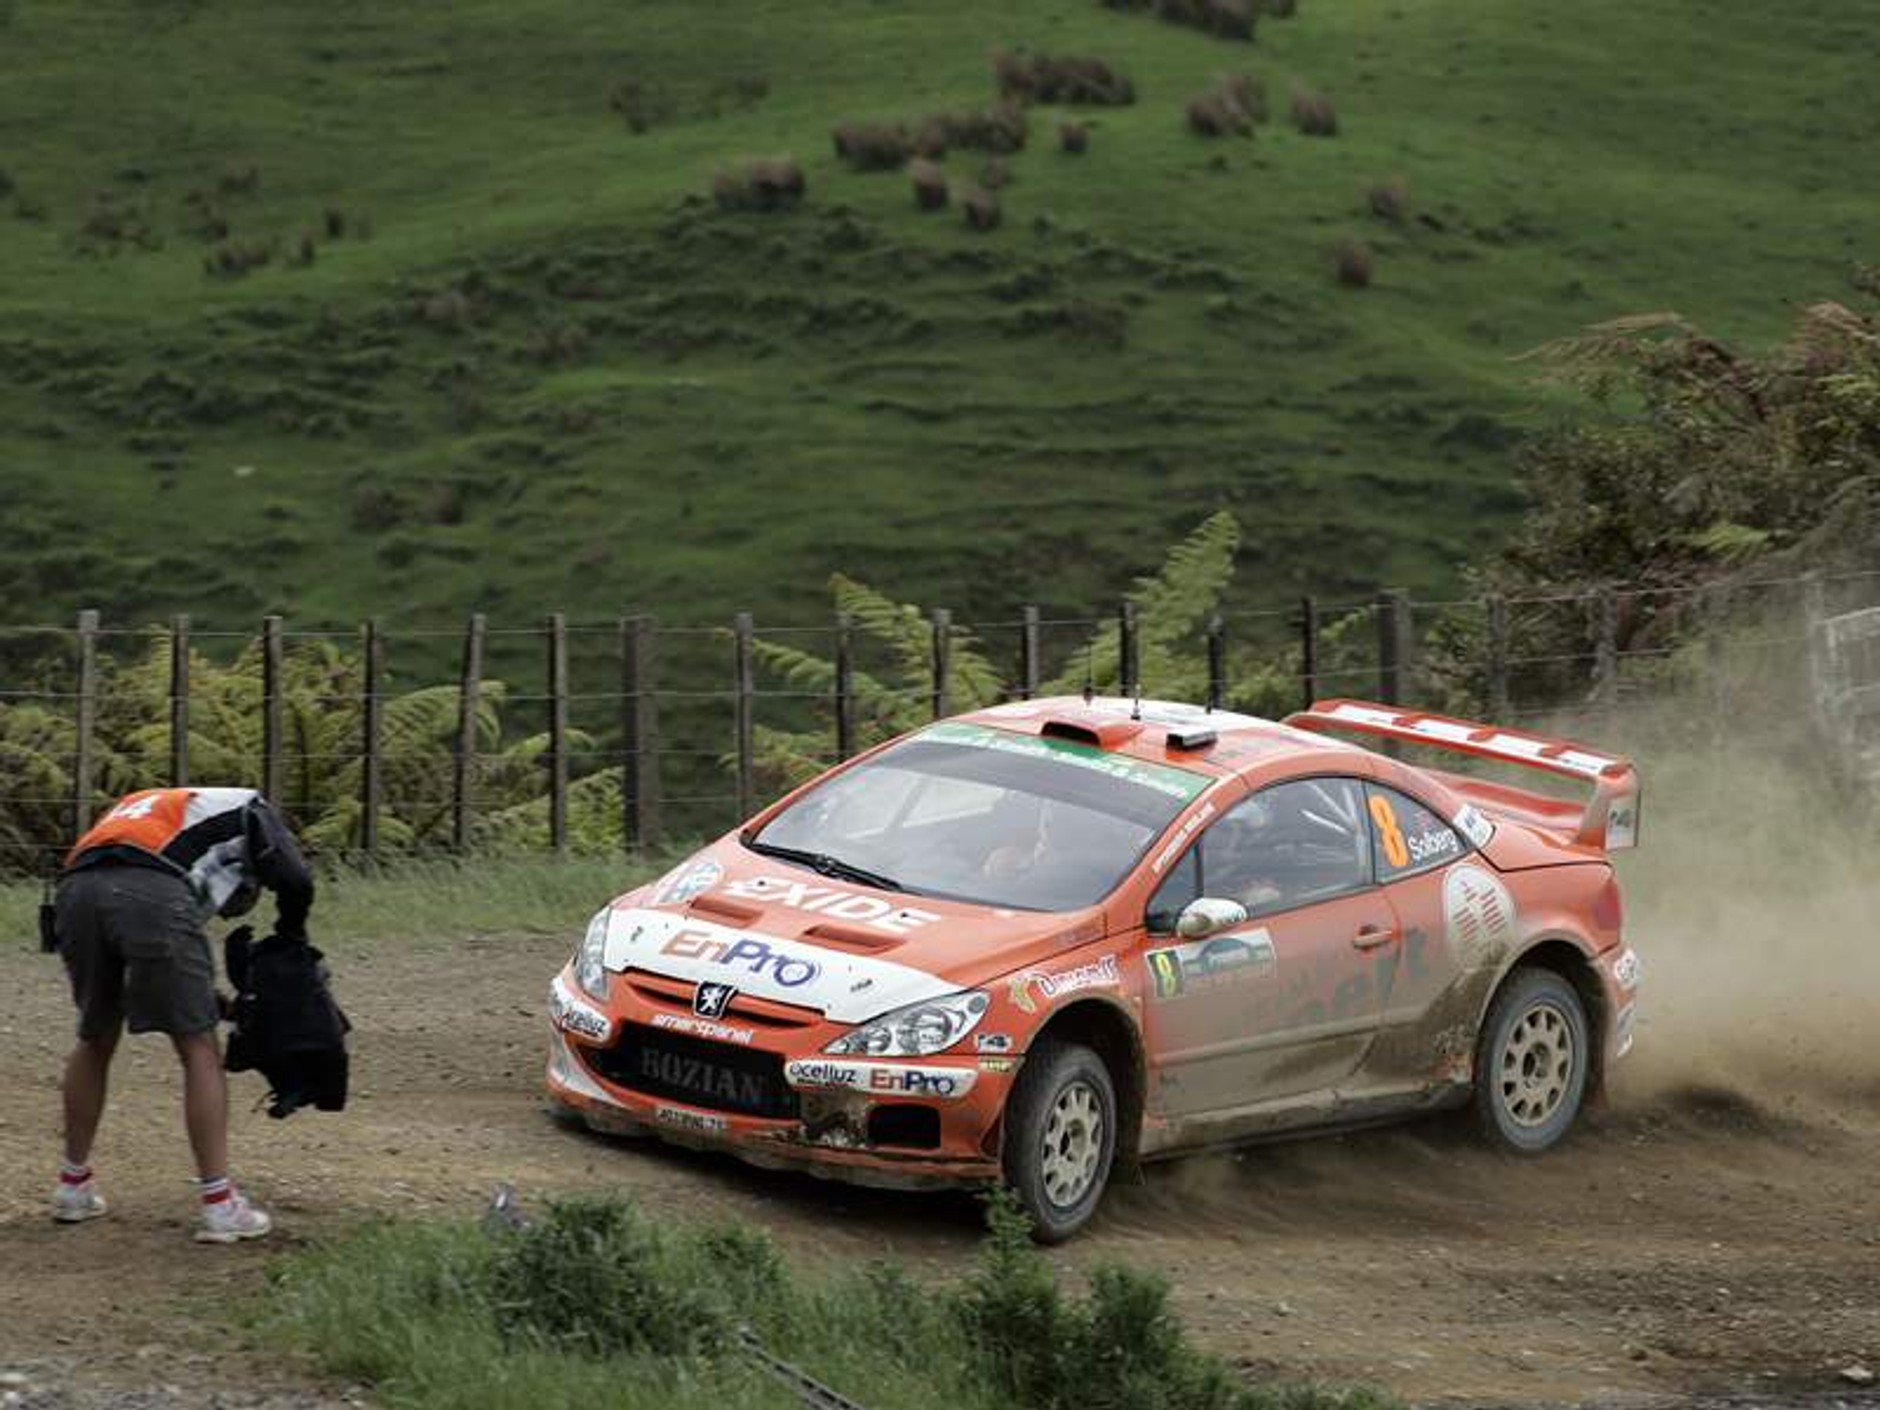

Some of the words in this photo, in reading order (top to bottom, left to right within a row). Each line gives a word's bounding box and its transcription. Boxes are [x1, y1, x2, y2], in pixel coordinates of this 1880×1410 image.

[1369, 793, 1409, 867] 8
[725, 875, 941, 933] EXIDE
[660, 929, 823, 987] EnPro
[870, 1068, 954, 1095] EnPro
